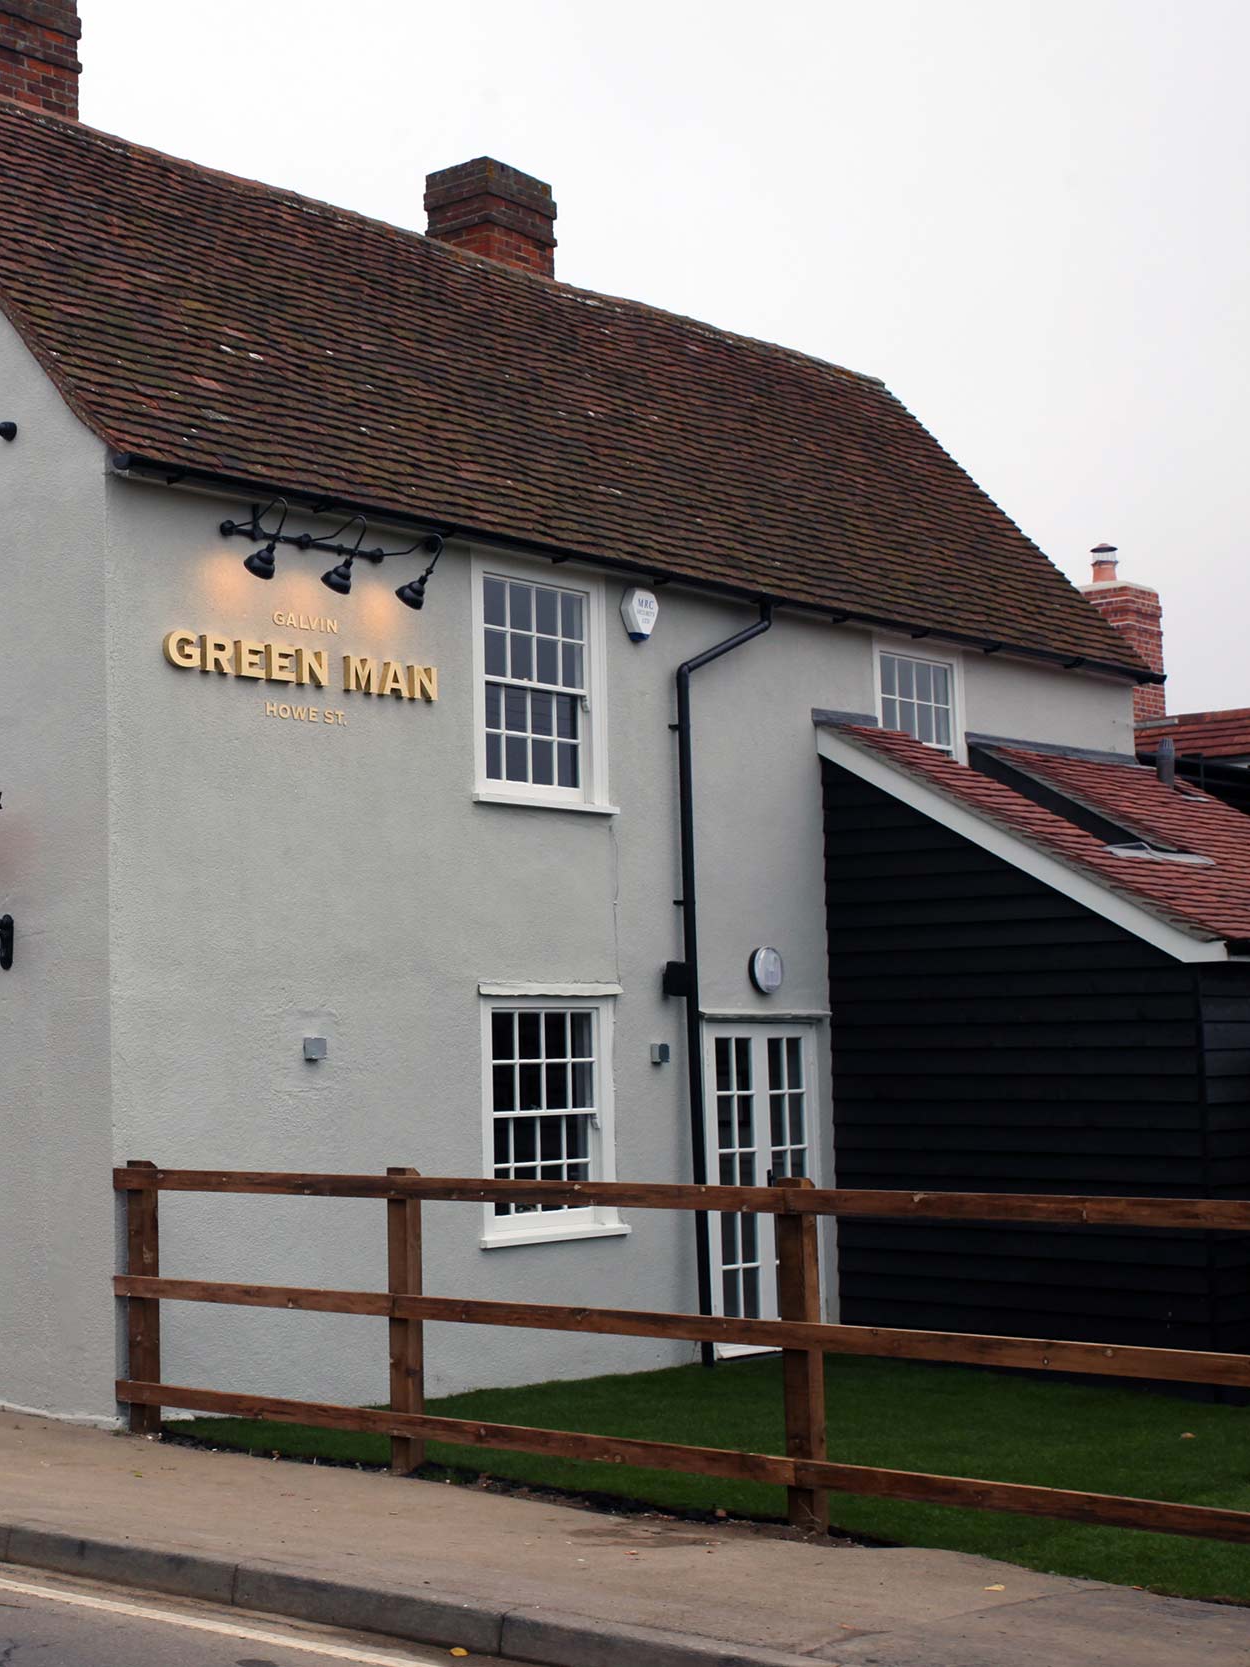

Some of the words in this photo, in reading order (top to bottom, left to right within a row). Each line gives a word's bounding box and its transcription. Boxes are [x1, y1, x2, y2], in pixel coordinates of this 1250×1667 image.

[272, 610, 339, 634] GALVIN
[162, 629, 329, 687] GREEN
[343, 654, 439, 701] MAN
[265, 701, 319, 722] HOWE
[323, 709, 348, 726] ST.
